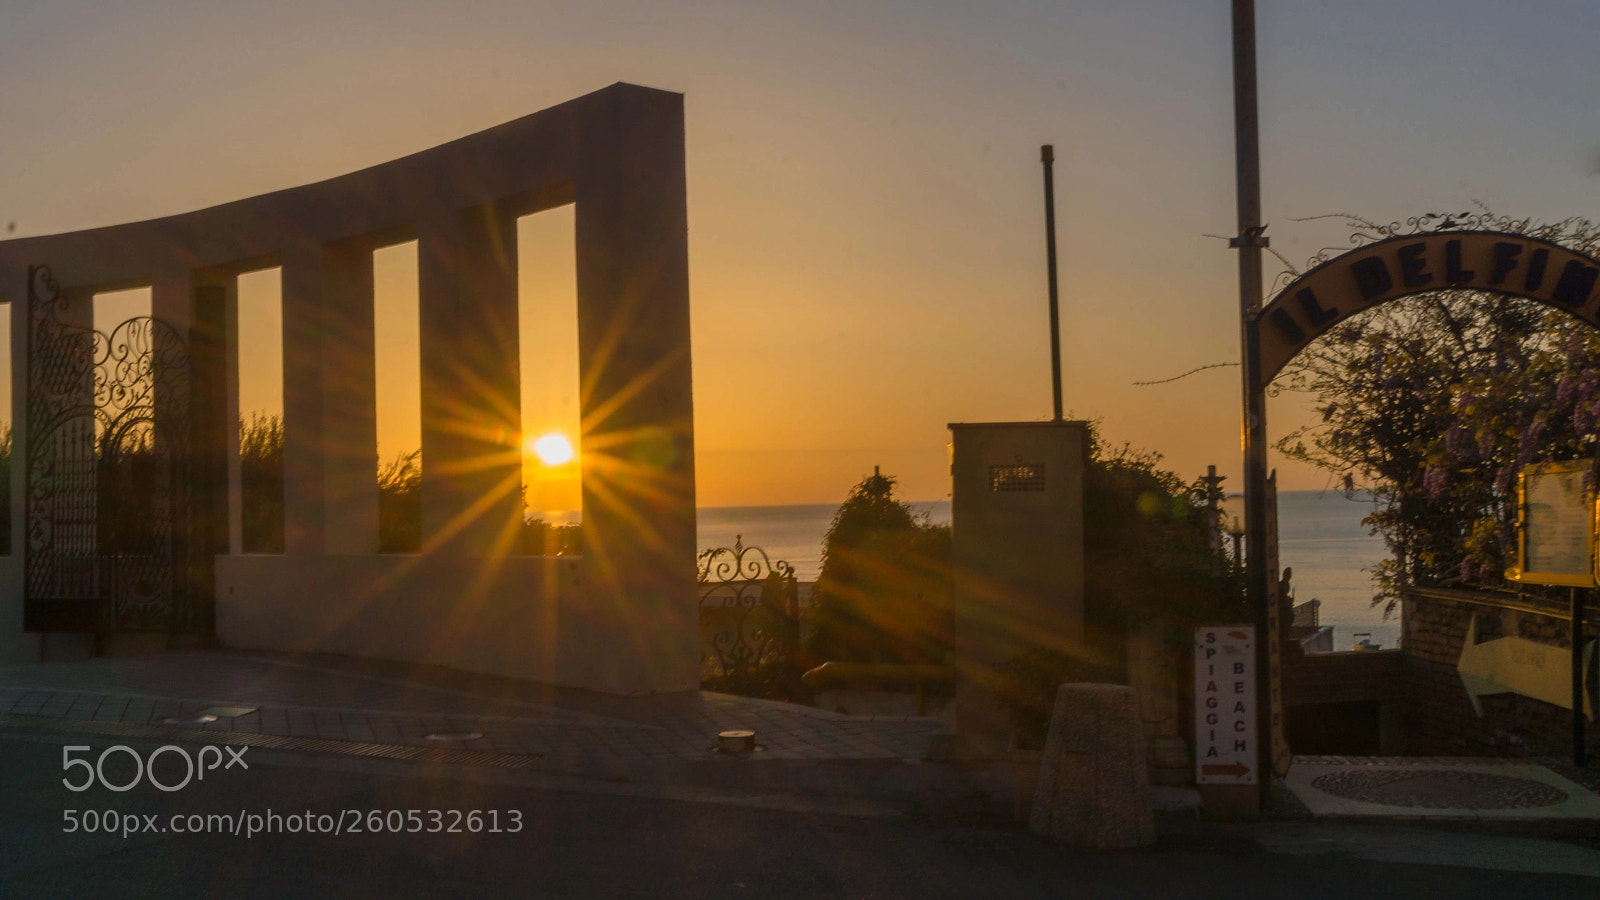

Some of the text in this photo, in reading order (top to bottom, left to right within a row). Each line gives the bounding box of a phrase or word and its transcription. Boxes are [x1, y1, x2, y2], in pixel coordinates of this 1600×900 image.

[1270, 239, 1600, 345] IL DELFIN
[1205, 632, 1219, 758] SPIAGGIA
[1233, 662, 1246, 752] BEACH
